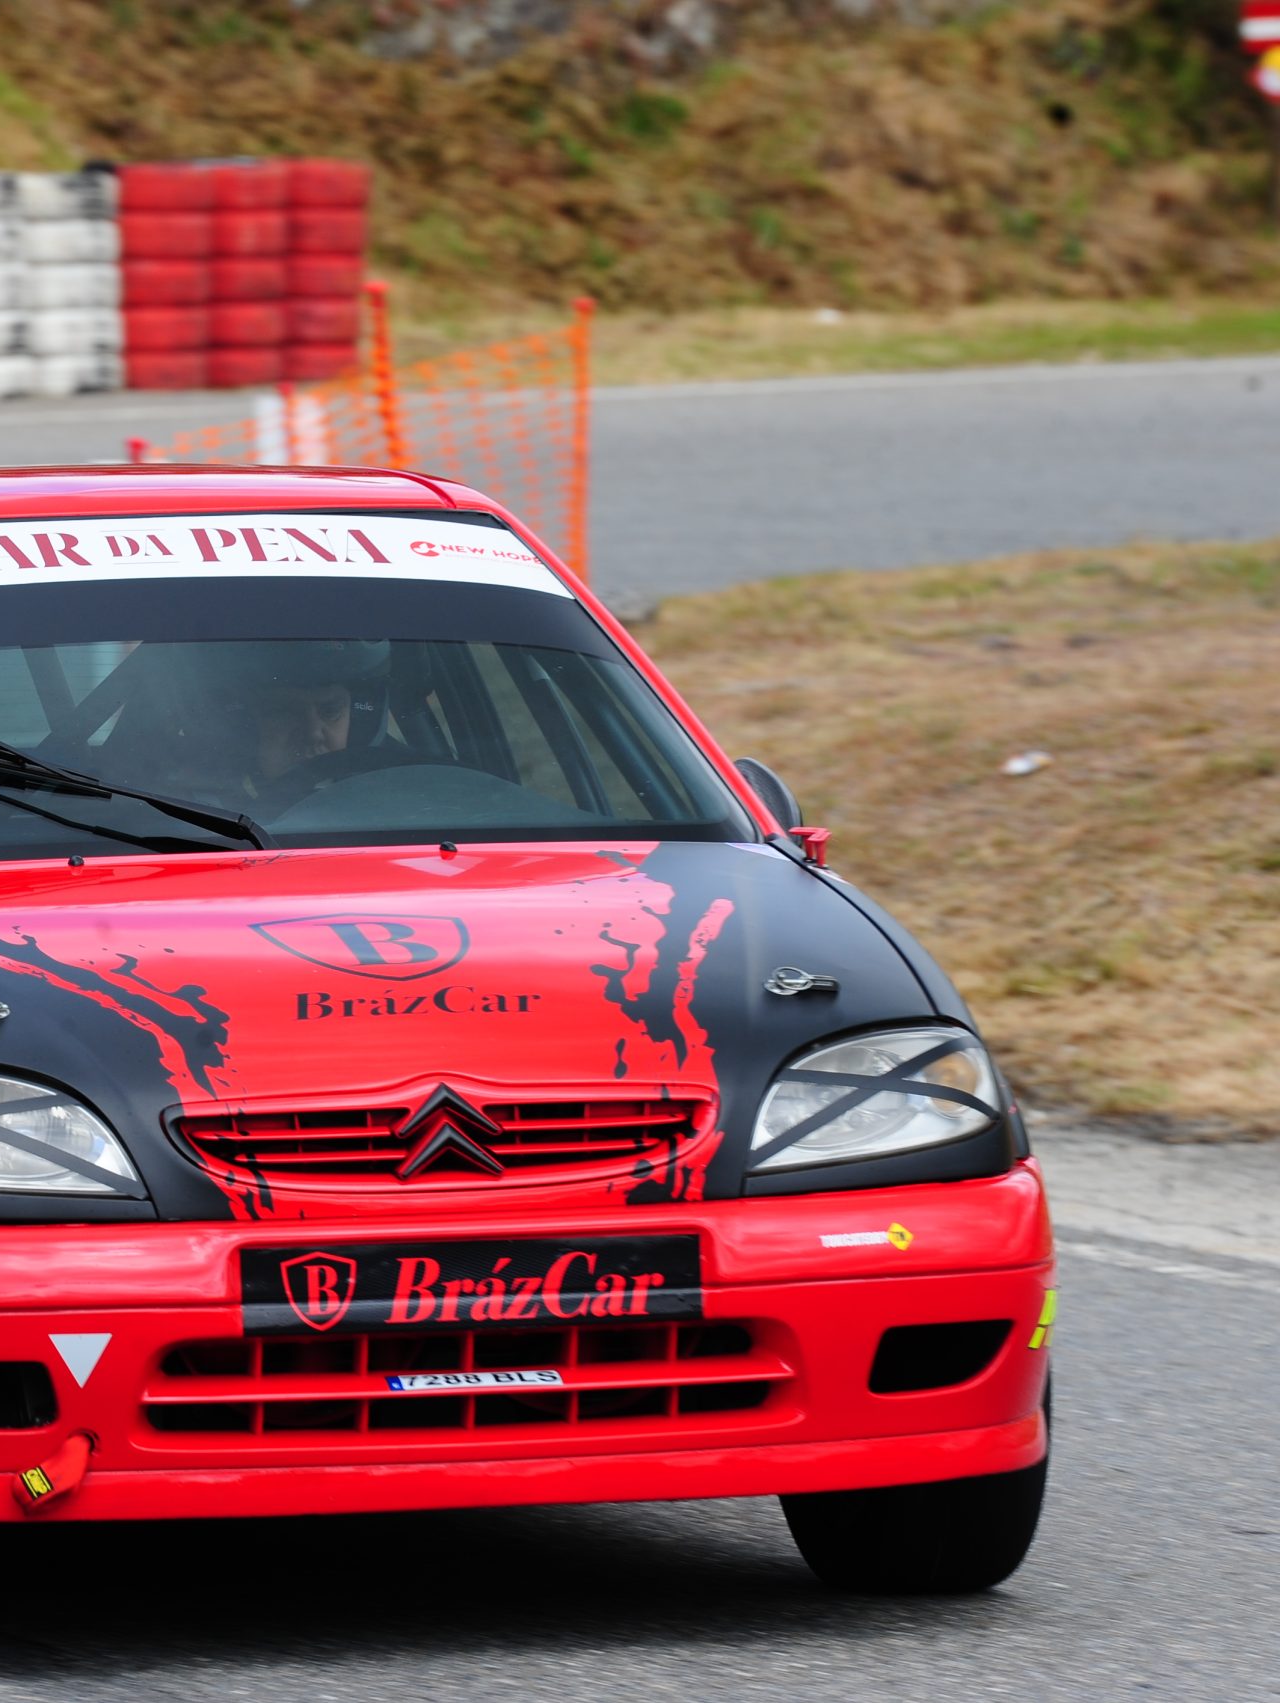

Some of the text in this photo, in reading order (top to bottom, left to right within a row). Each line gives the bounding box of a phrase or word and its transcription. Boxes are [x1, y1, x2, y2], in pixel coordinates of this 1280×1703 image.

[104, 533, 174, 558] DA
[189, 527, 393, 564] PENA
[440, 543, 485, 555] NEW
[312, 921, 439, 966] B
[295, 985, 542, 1020] BrázCar
[303, 1250, 664, 1324] B BrázCar
[402, 1370, 558, 1387] 7288 BLS
